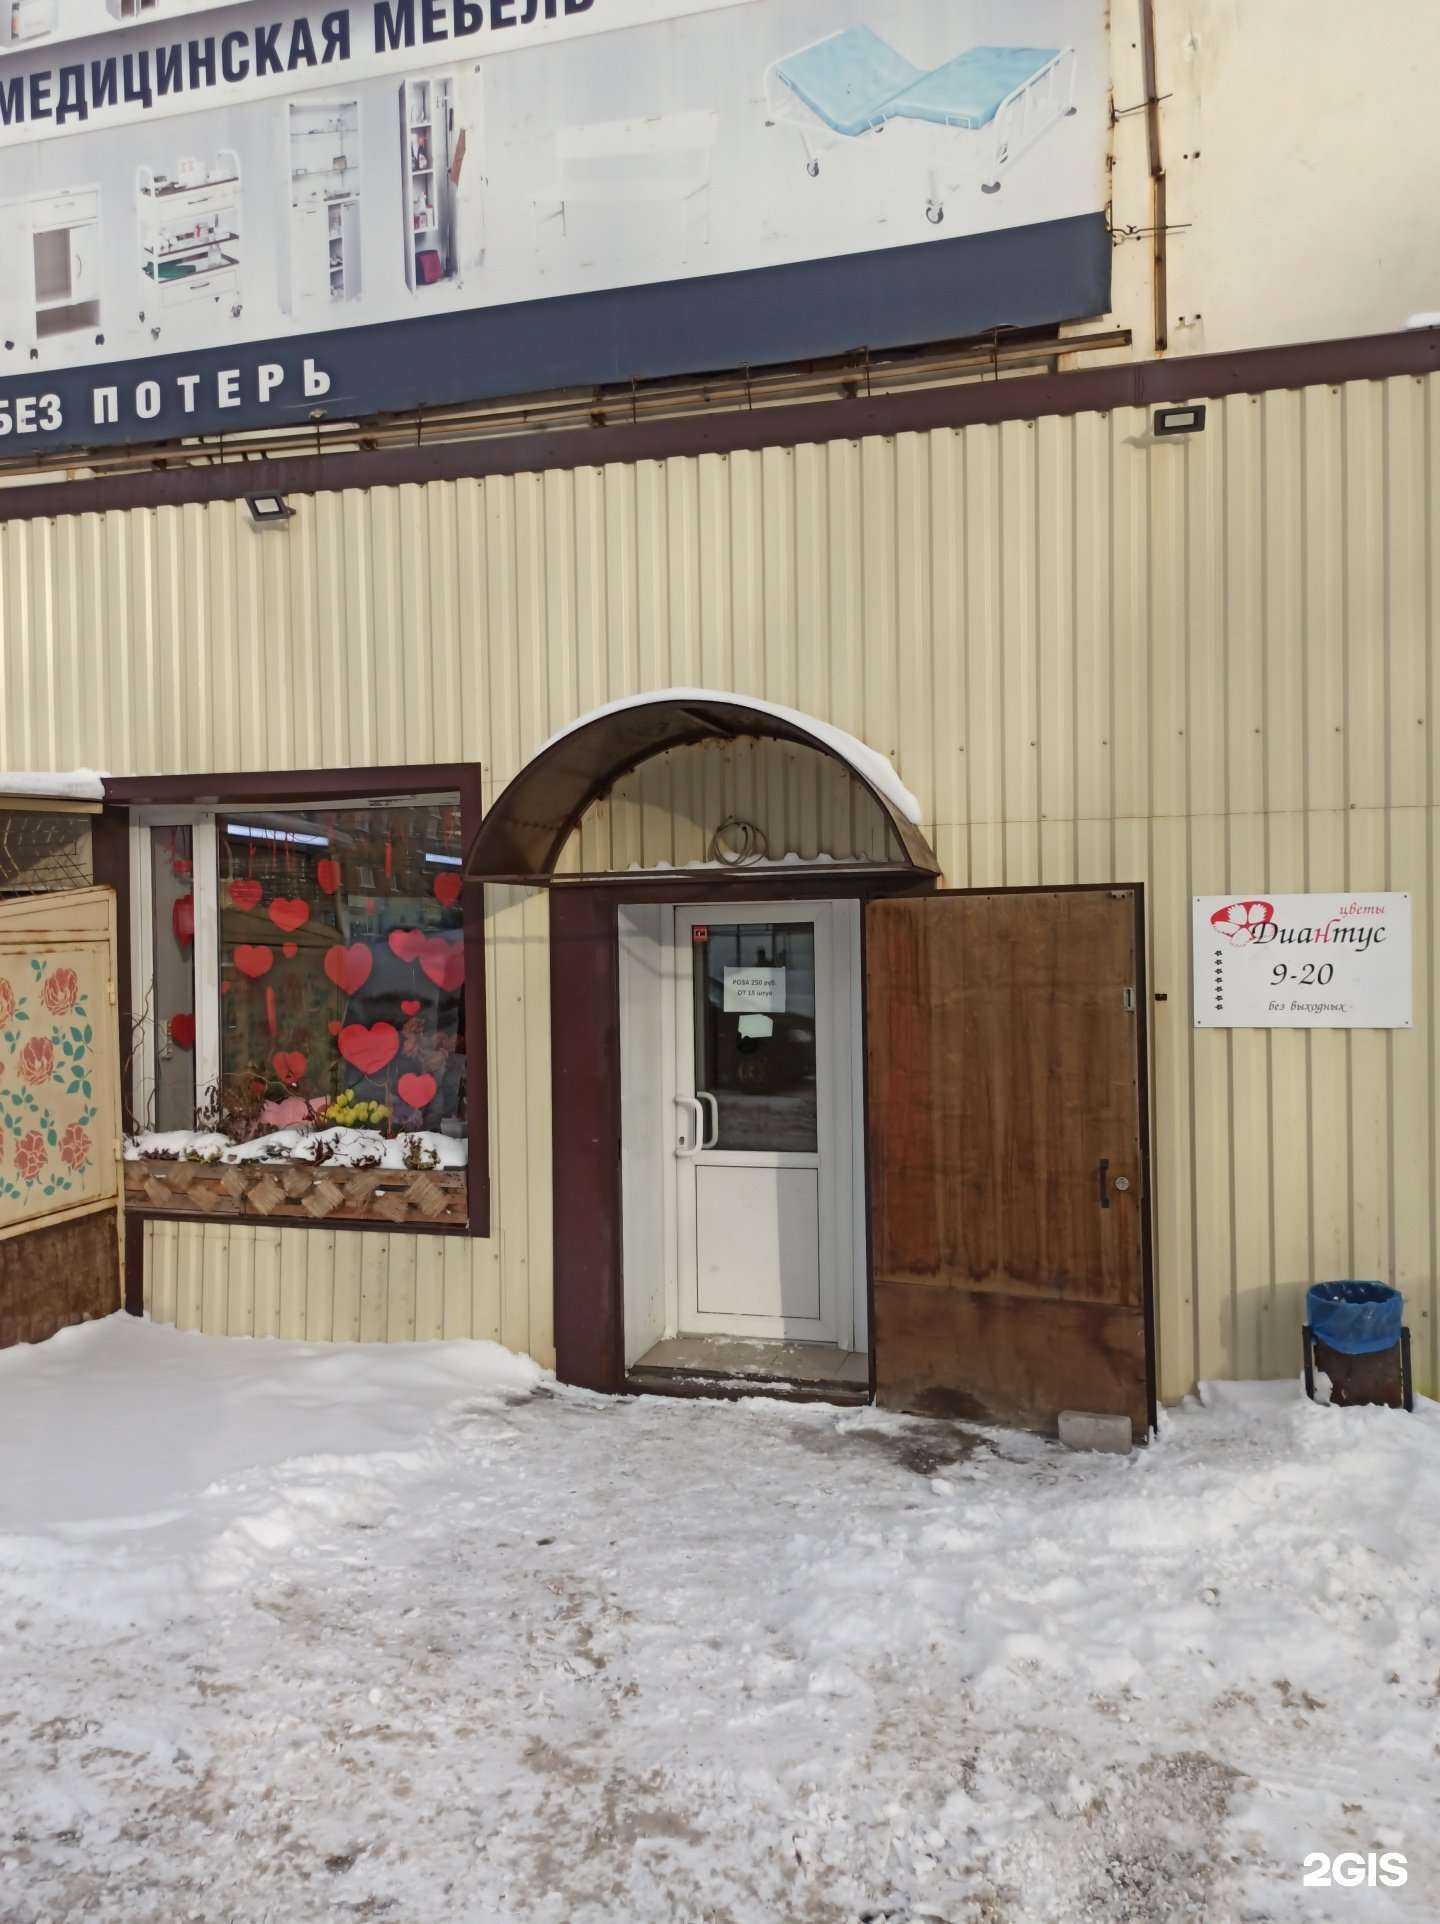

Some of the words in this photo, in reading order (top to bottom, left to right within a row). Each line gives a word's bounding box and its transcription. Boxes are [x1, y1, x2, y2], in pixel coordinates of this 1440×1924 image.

[0, 9, 351, 126] МЕДИЦИНСКАЯ
[92, 358, 331, 424] ПОТЕРЬ
[1339, 902, 1385, 917] цветы
[1270, 963, 1335, 986] 9-20
[1268, 1000, 1286, 1011] без
[1290, 1000, 1348, 1014] выходных
